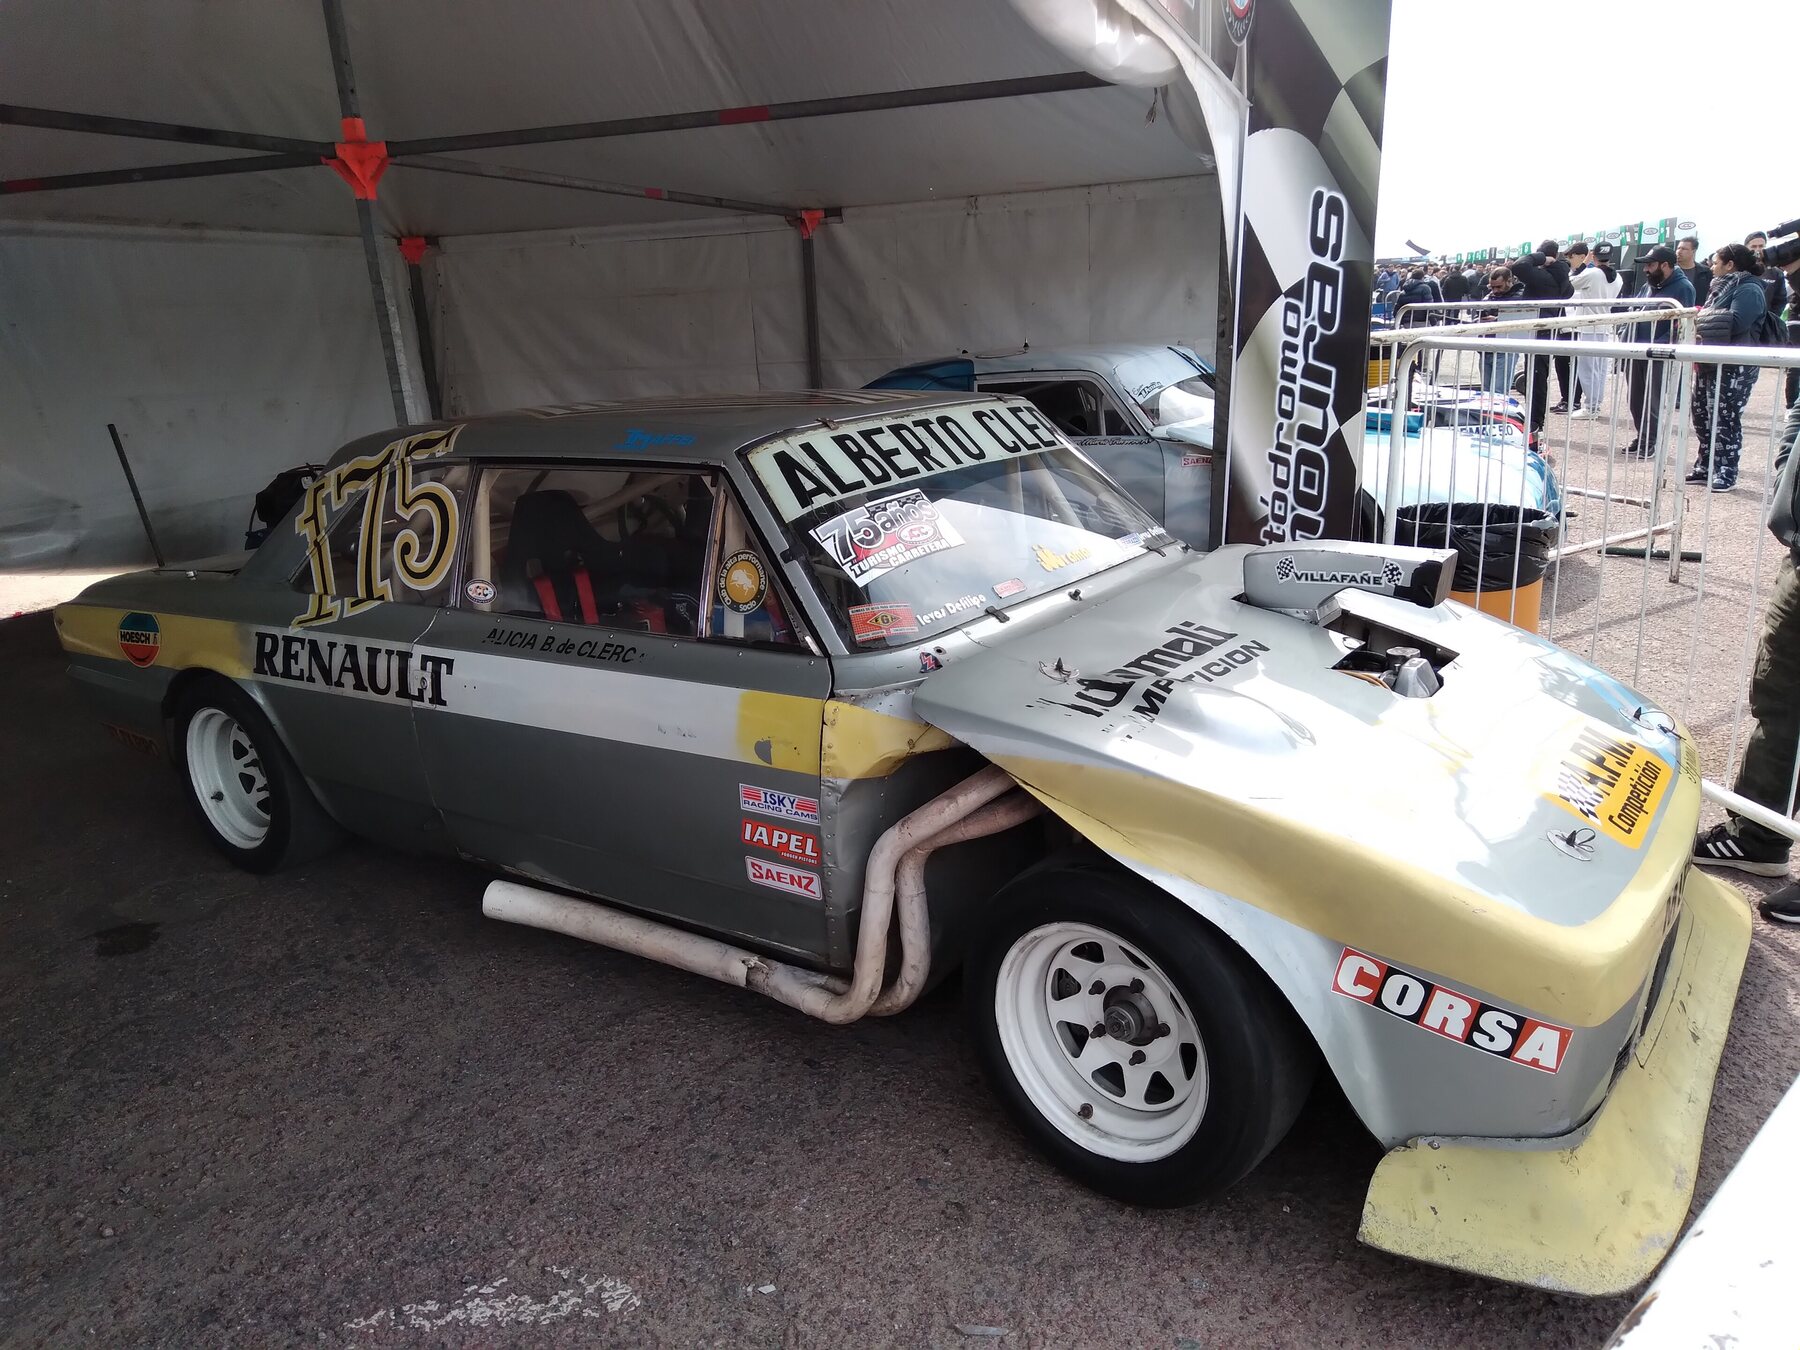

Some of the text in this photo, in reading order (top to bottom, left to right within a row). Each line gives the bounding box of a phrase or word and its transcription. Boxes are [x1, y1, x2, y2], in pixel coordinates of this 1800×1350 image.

[1260, 300, 1302, 546] tódromo
[773, 415, 987, 509] ALBERTO
[289, 424, 467, 632] 175
[815, 500, 939, 566] 75 años
[851, 544, 906, 578] TURISMO
[888, 538, 950, 567] CARRETERA
[1293, 572, 1383, 585] VILLAFAÑE
[739, 600, 757, 611] Socio
[120, 631, 151, 645] HOESCH
[482, 628, 636, 663] ALICIA B. de CLERC
[254, 631, 454, 707] RENAULT
[743, 800, 818, 821] RACING CAMS
[762, 791, 796, 809] ISKY
[744, 823, 818, 857] IAPEL
[751, 862, 816, 895] SAENZ
[1338, 955, 1561, 1069] CORSA
